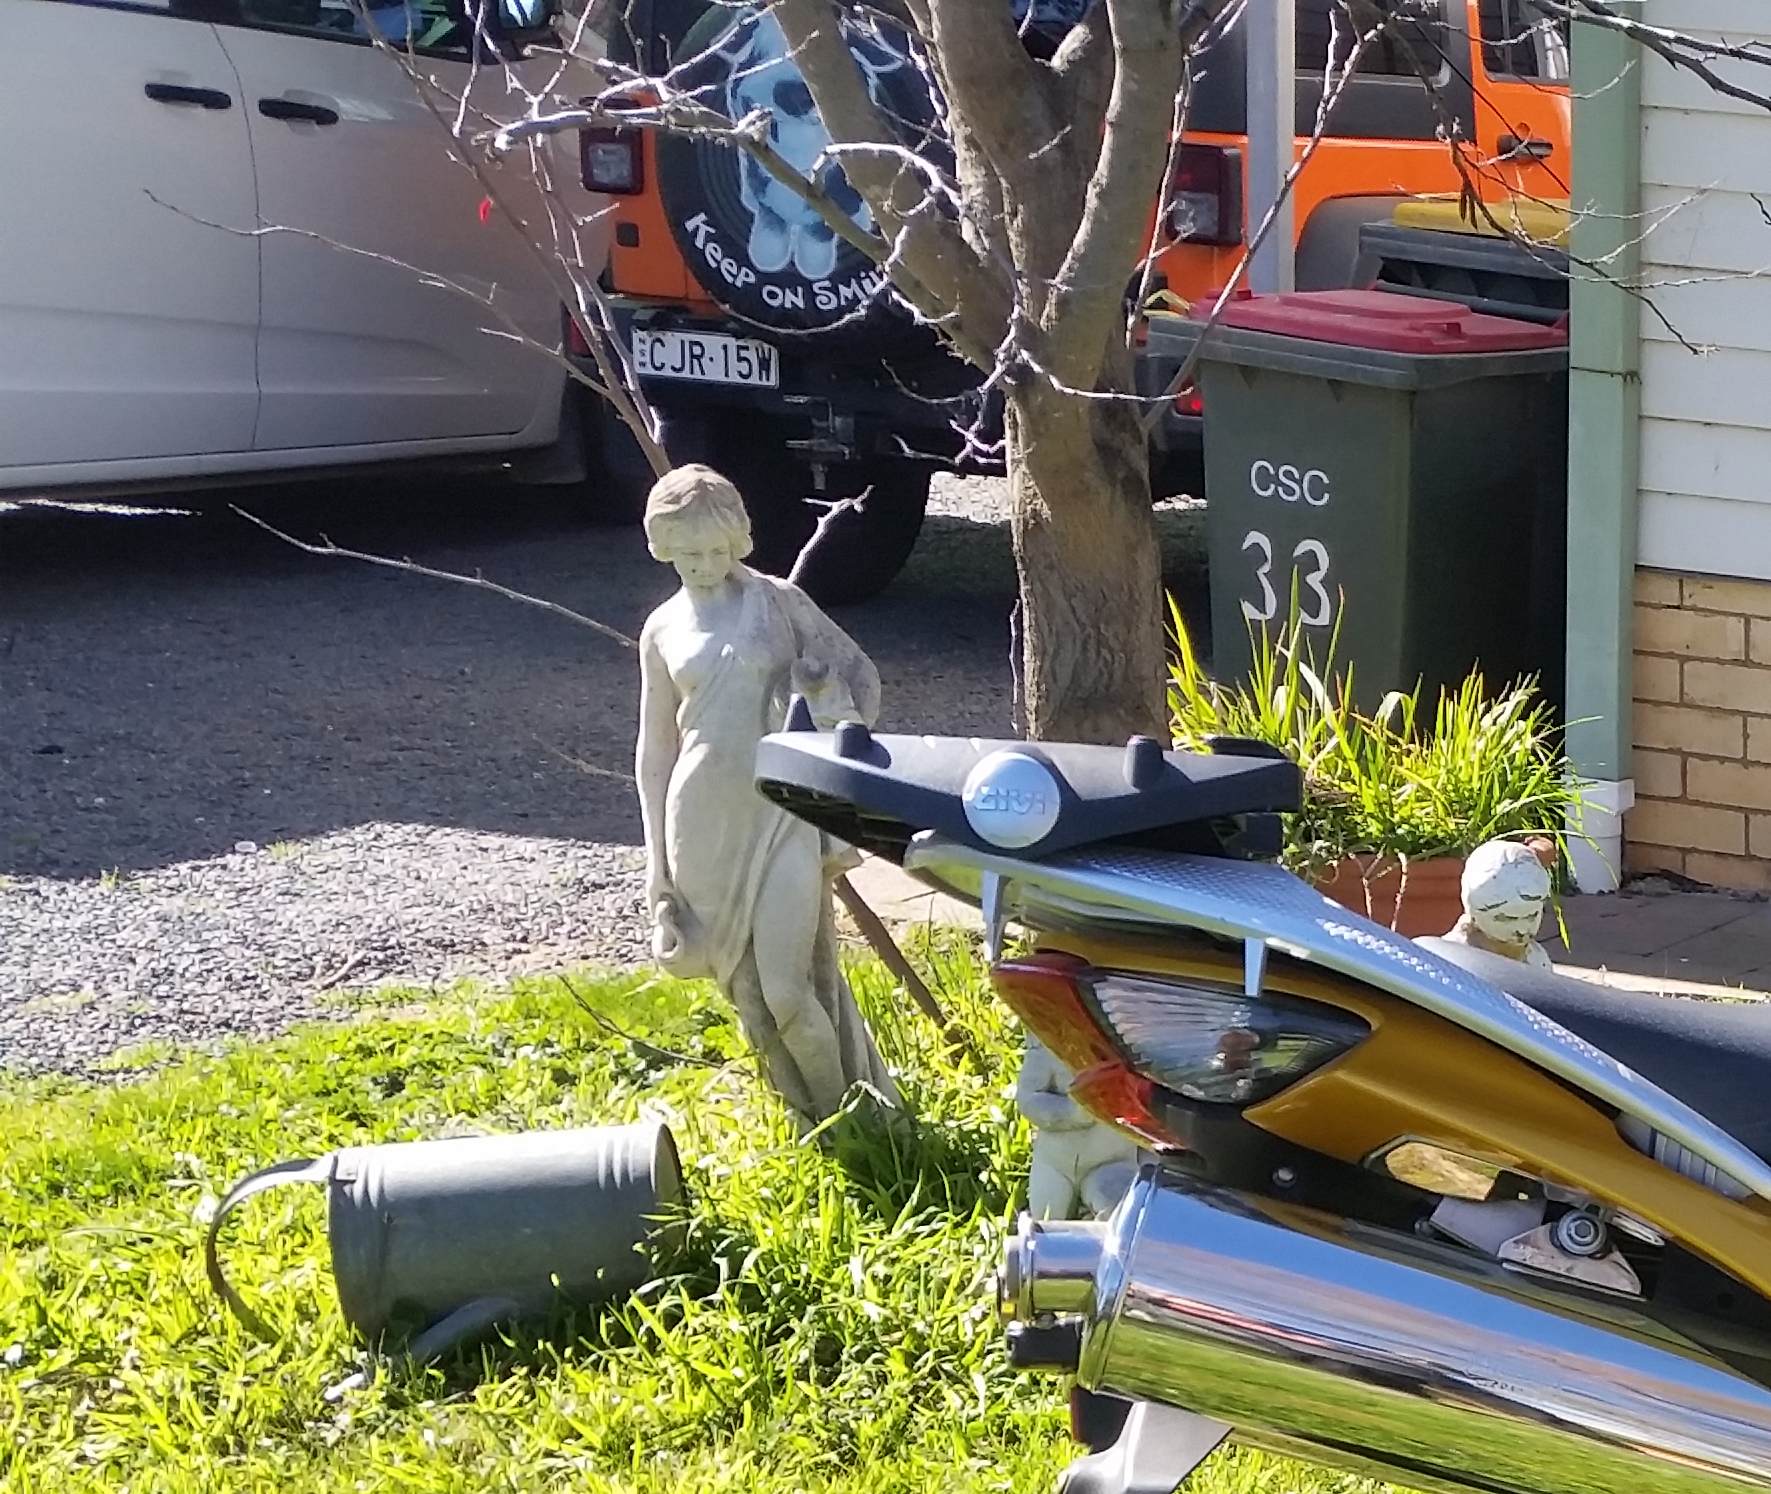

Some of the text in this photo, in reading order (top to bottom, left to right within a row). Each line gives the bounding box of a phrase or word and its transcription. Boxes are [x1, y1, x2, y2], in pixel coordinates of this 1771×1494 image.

[762, 284, 805, 309] ON
[1250, 460, 1330, 506] CSC
[1241, 530, 1331, 626] 33
[974, 785, 1046, 815] GIVI
